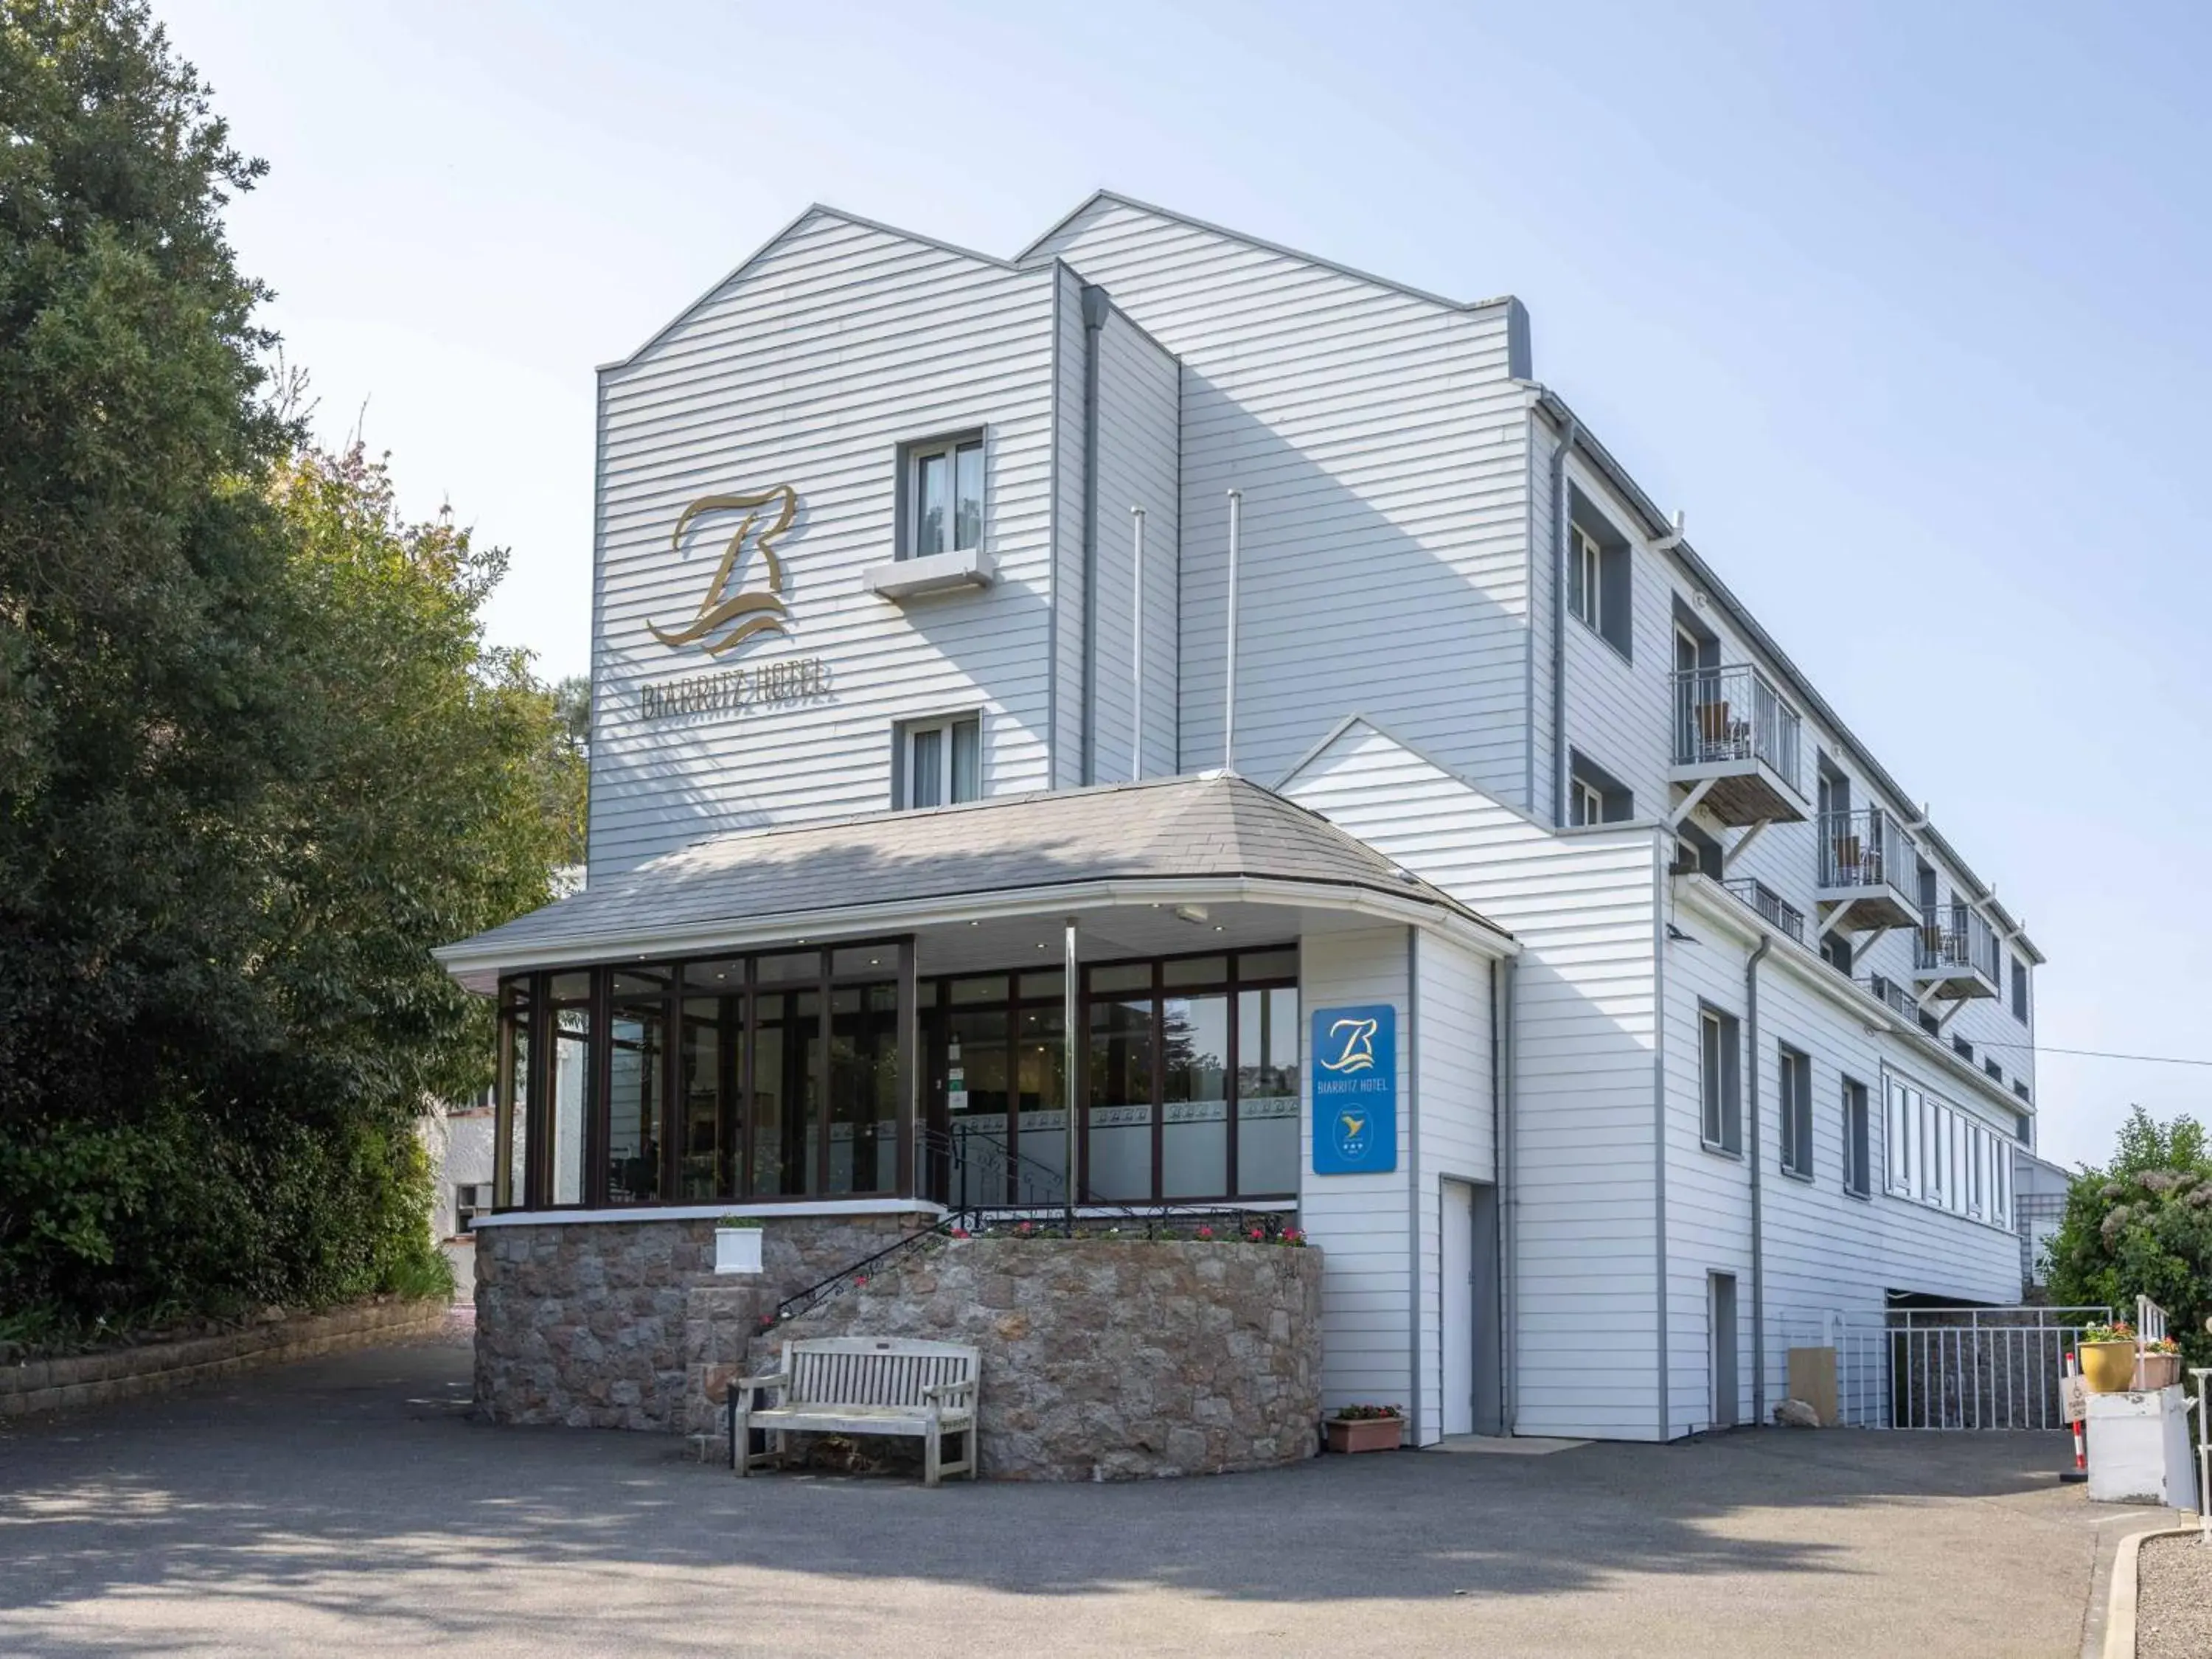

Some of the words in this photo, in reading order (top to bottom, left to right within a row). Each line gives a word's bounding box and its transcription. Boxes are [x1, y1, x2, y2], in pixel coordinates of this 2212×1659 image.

[641, 669, 745, 720] BIARRITZ
[756, 656, 828, 702] HOTEL
[1318, 1079, 1357, 1095] BIARRITZ
[1360, 1077, 1389, 1092] HOTEL
